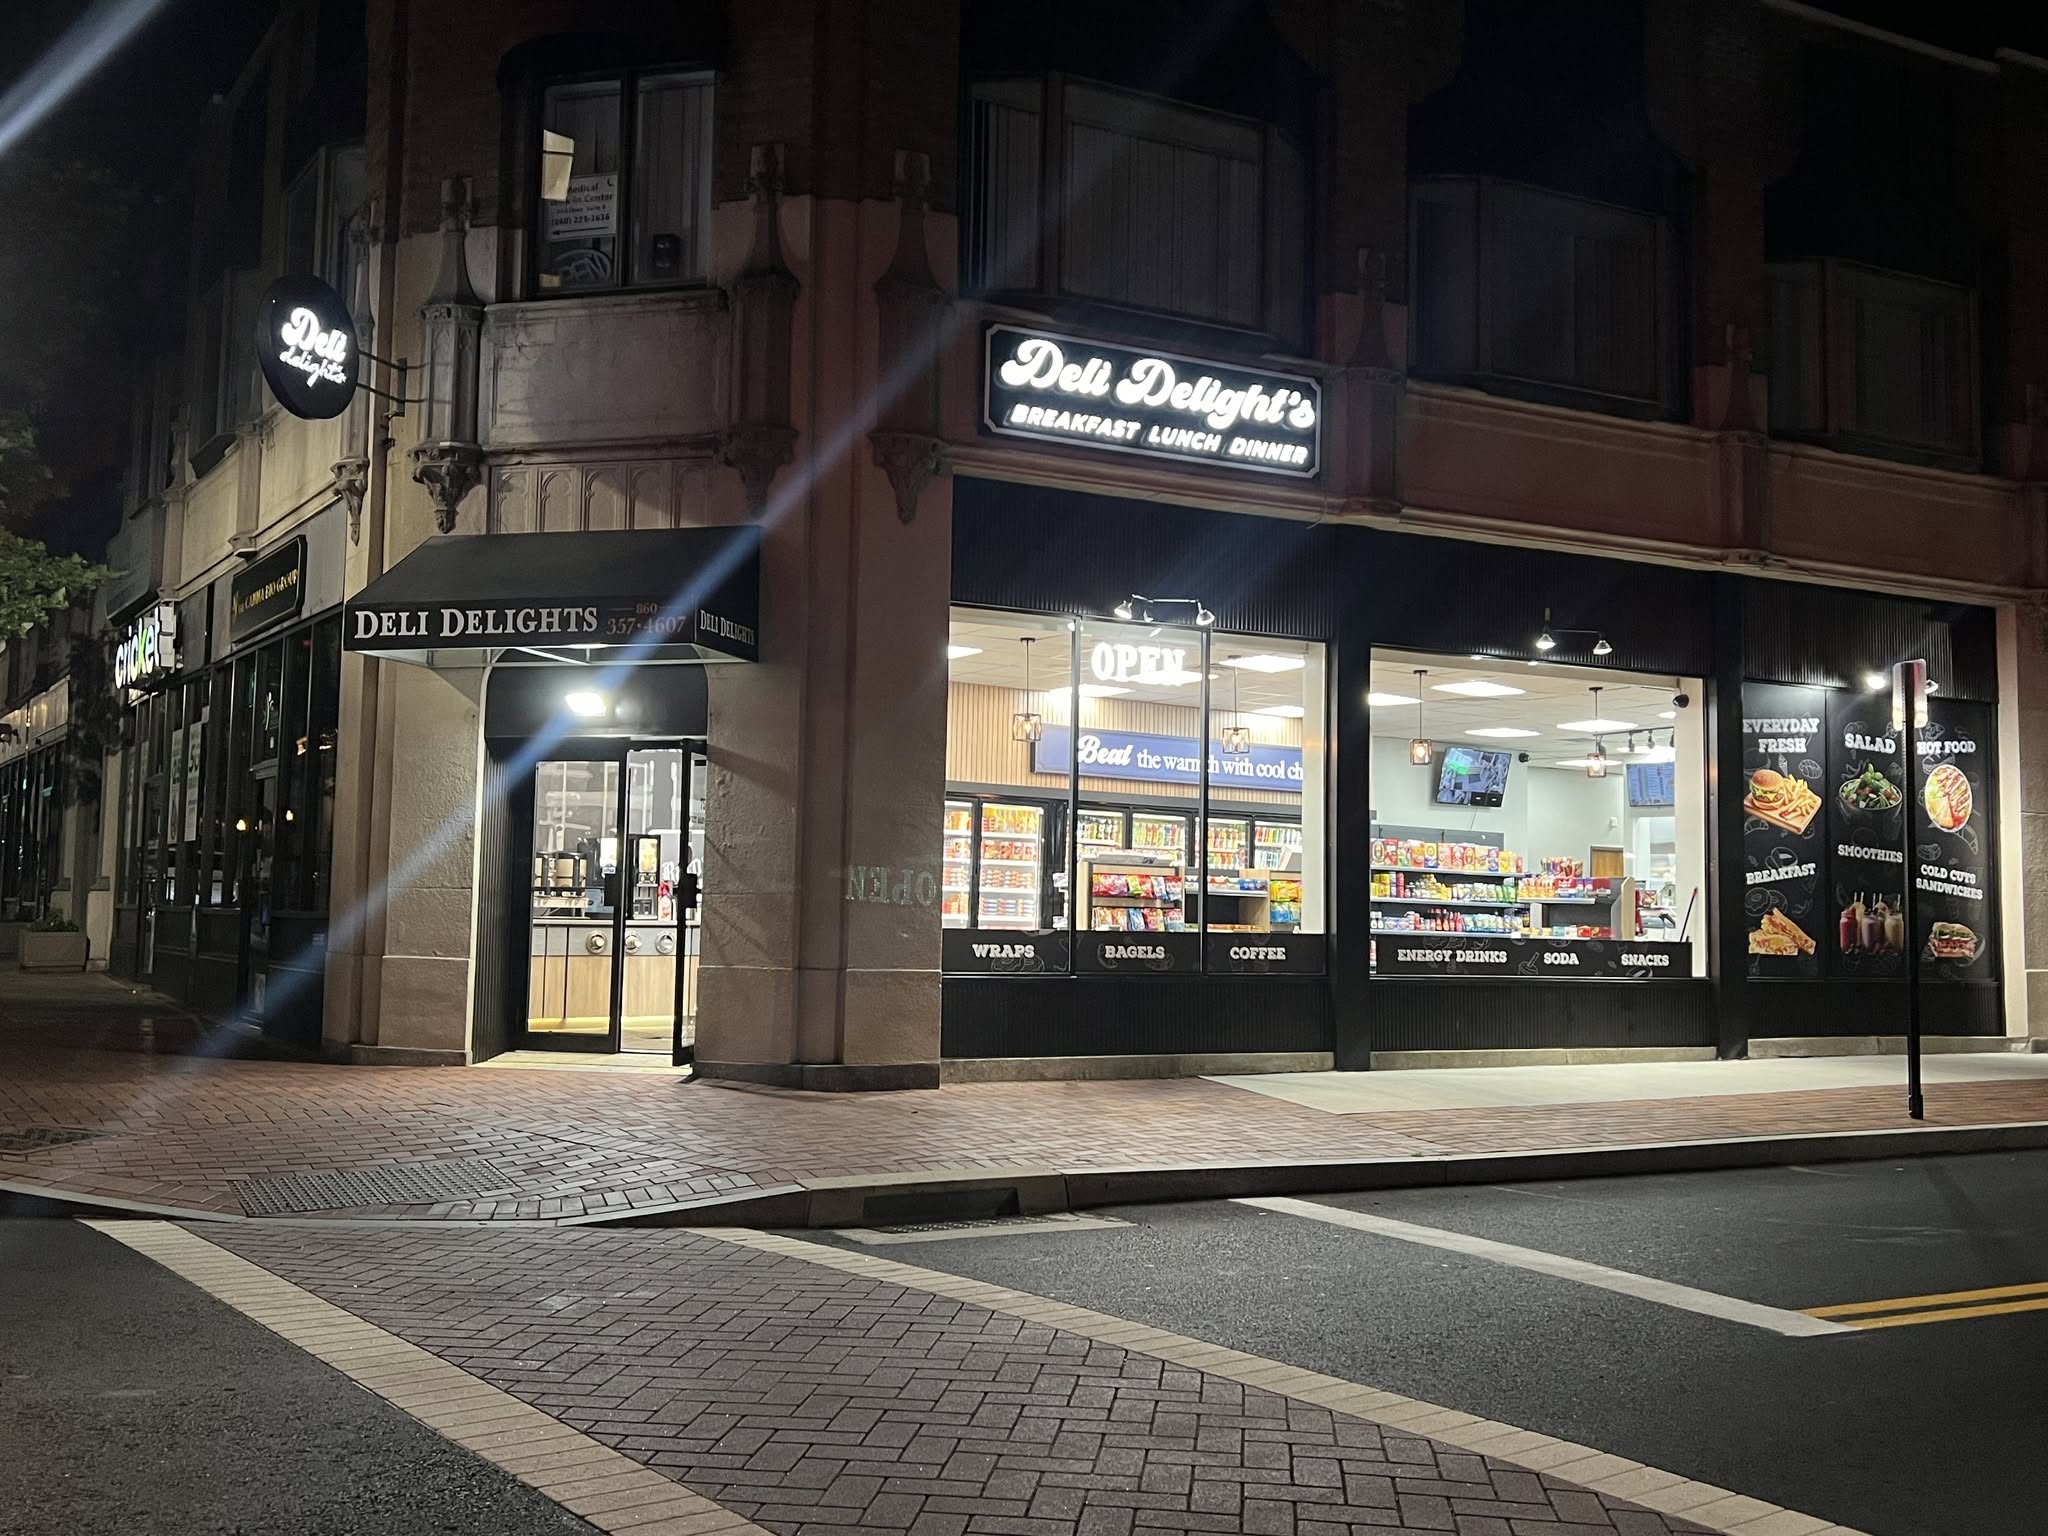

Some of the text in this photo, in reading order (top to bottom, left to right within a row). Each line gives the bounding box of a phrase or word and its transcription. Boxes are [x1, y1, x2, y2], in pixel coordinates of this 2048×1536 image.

[281, 306, 348, 363] Deli
[1000, 338, 1316, 430] Deli Delight's
[1010, 403, 1309, 465] BREAKFAST LUNCH DINNER
[636, 602, 658, 614] 860
[354, 606, 598, 640] DELI DELIGHTS
[700, 609, 755, 646] DELI DELIGHTS
[114, 606, 160, 690] cricket
[1091, 642, 1186, 686] OPEN
[1742, 718, 1820, 733] EVERYDAY
[1758, 737, 1807, 753] FRESH
[1844, 733, 1896, 754] SALAD
[1916, 740, 1977, 755] HOT FOOD
[1078, 735, 1134, 766] Beat
[1137, 748, 1161, 769] the
[1222, 757, 1255, 778] with
[1256, 759, 1286, 779] cool
[1837, 844, 1903, 864] SMOOTHIES
[1746, 862, 1816, 885] BREAKFAST
[1920, 863, 1977, 885] COLD CUTS
[1916, 877, 1983, 900] SANDWICHES
[972, 943, 1035, 959] WRAPS
[1104, 945, 1166, 960] BAGELS
[1230, 946, 1287, 961] COFFEE
[1397, 949, 1508, 964] ENERGY DRINKS
[1543, 952, 1580, 966] SODA
[1620, 953, 1670, 967] SNACKS
